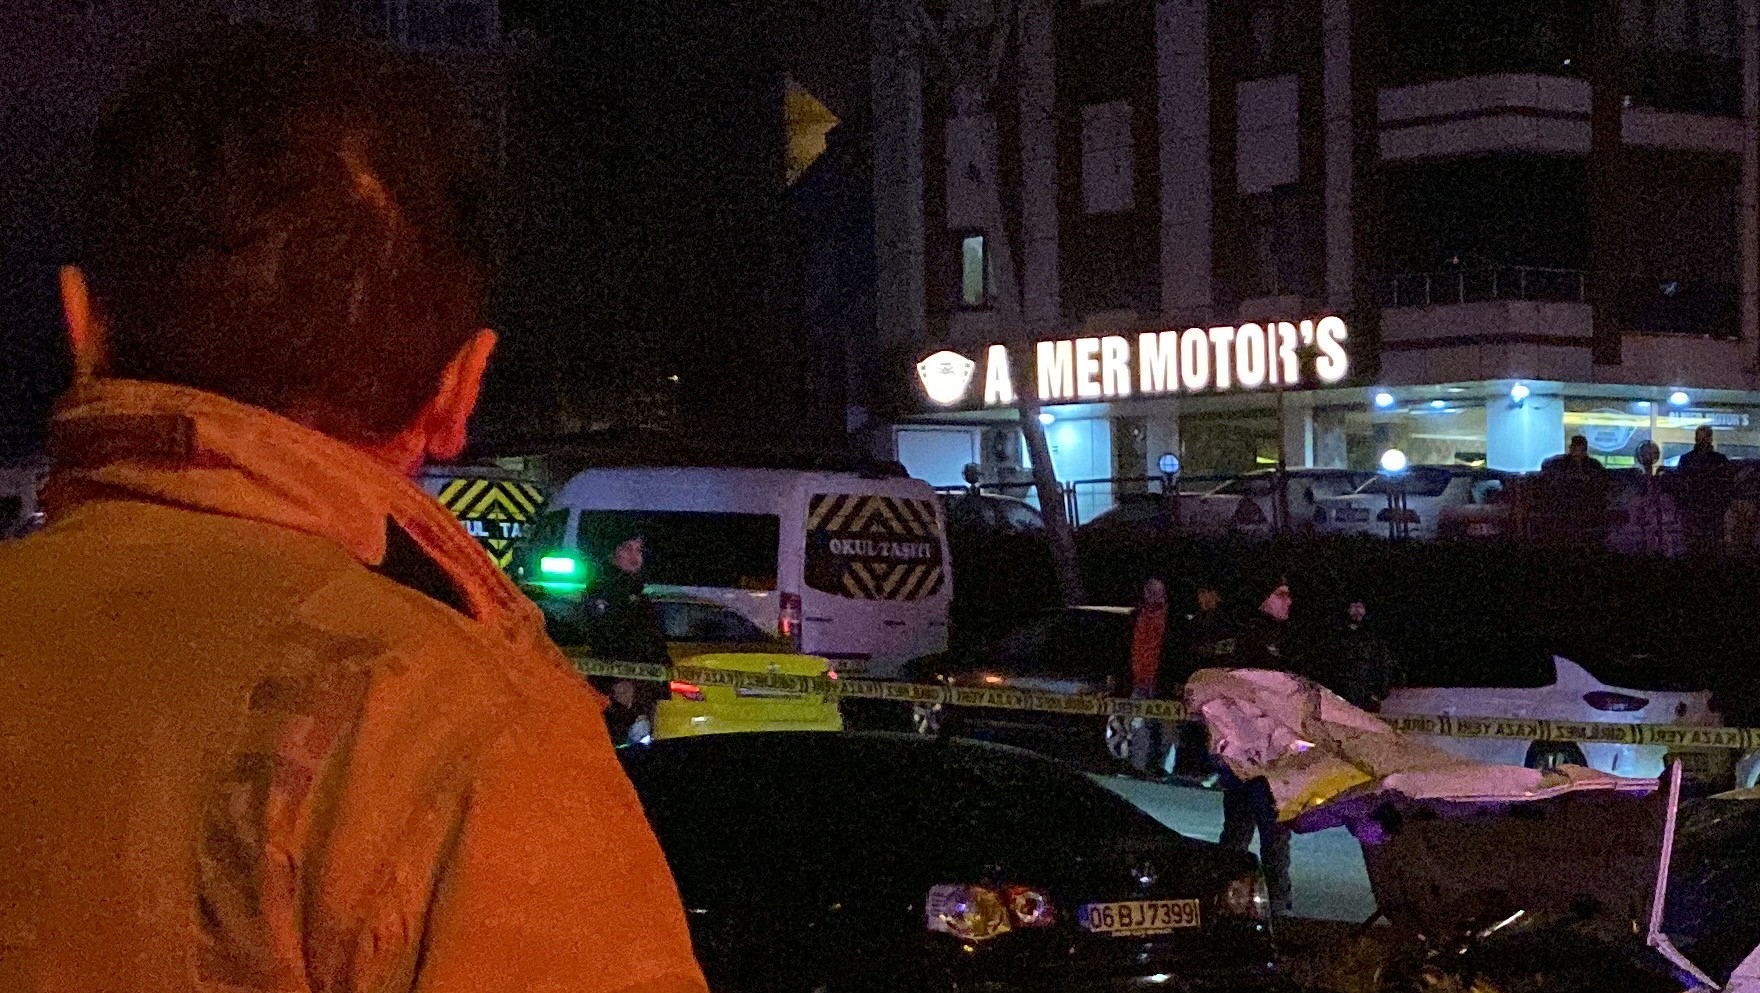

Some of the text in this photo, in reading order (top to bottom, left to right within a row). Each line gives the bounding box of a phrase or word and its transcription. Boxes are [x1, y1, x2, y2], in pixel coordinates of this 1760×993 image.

[983, 316, 1349, 405] AMER MOTOR'S
[829, 538, 877, 556] OKUL
